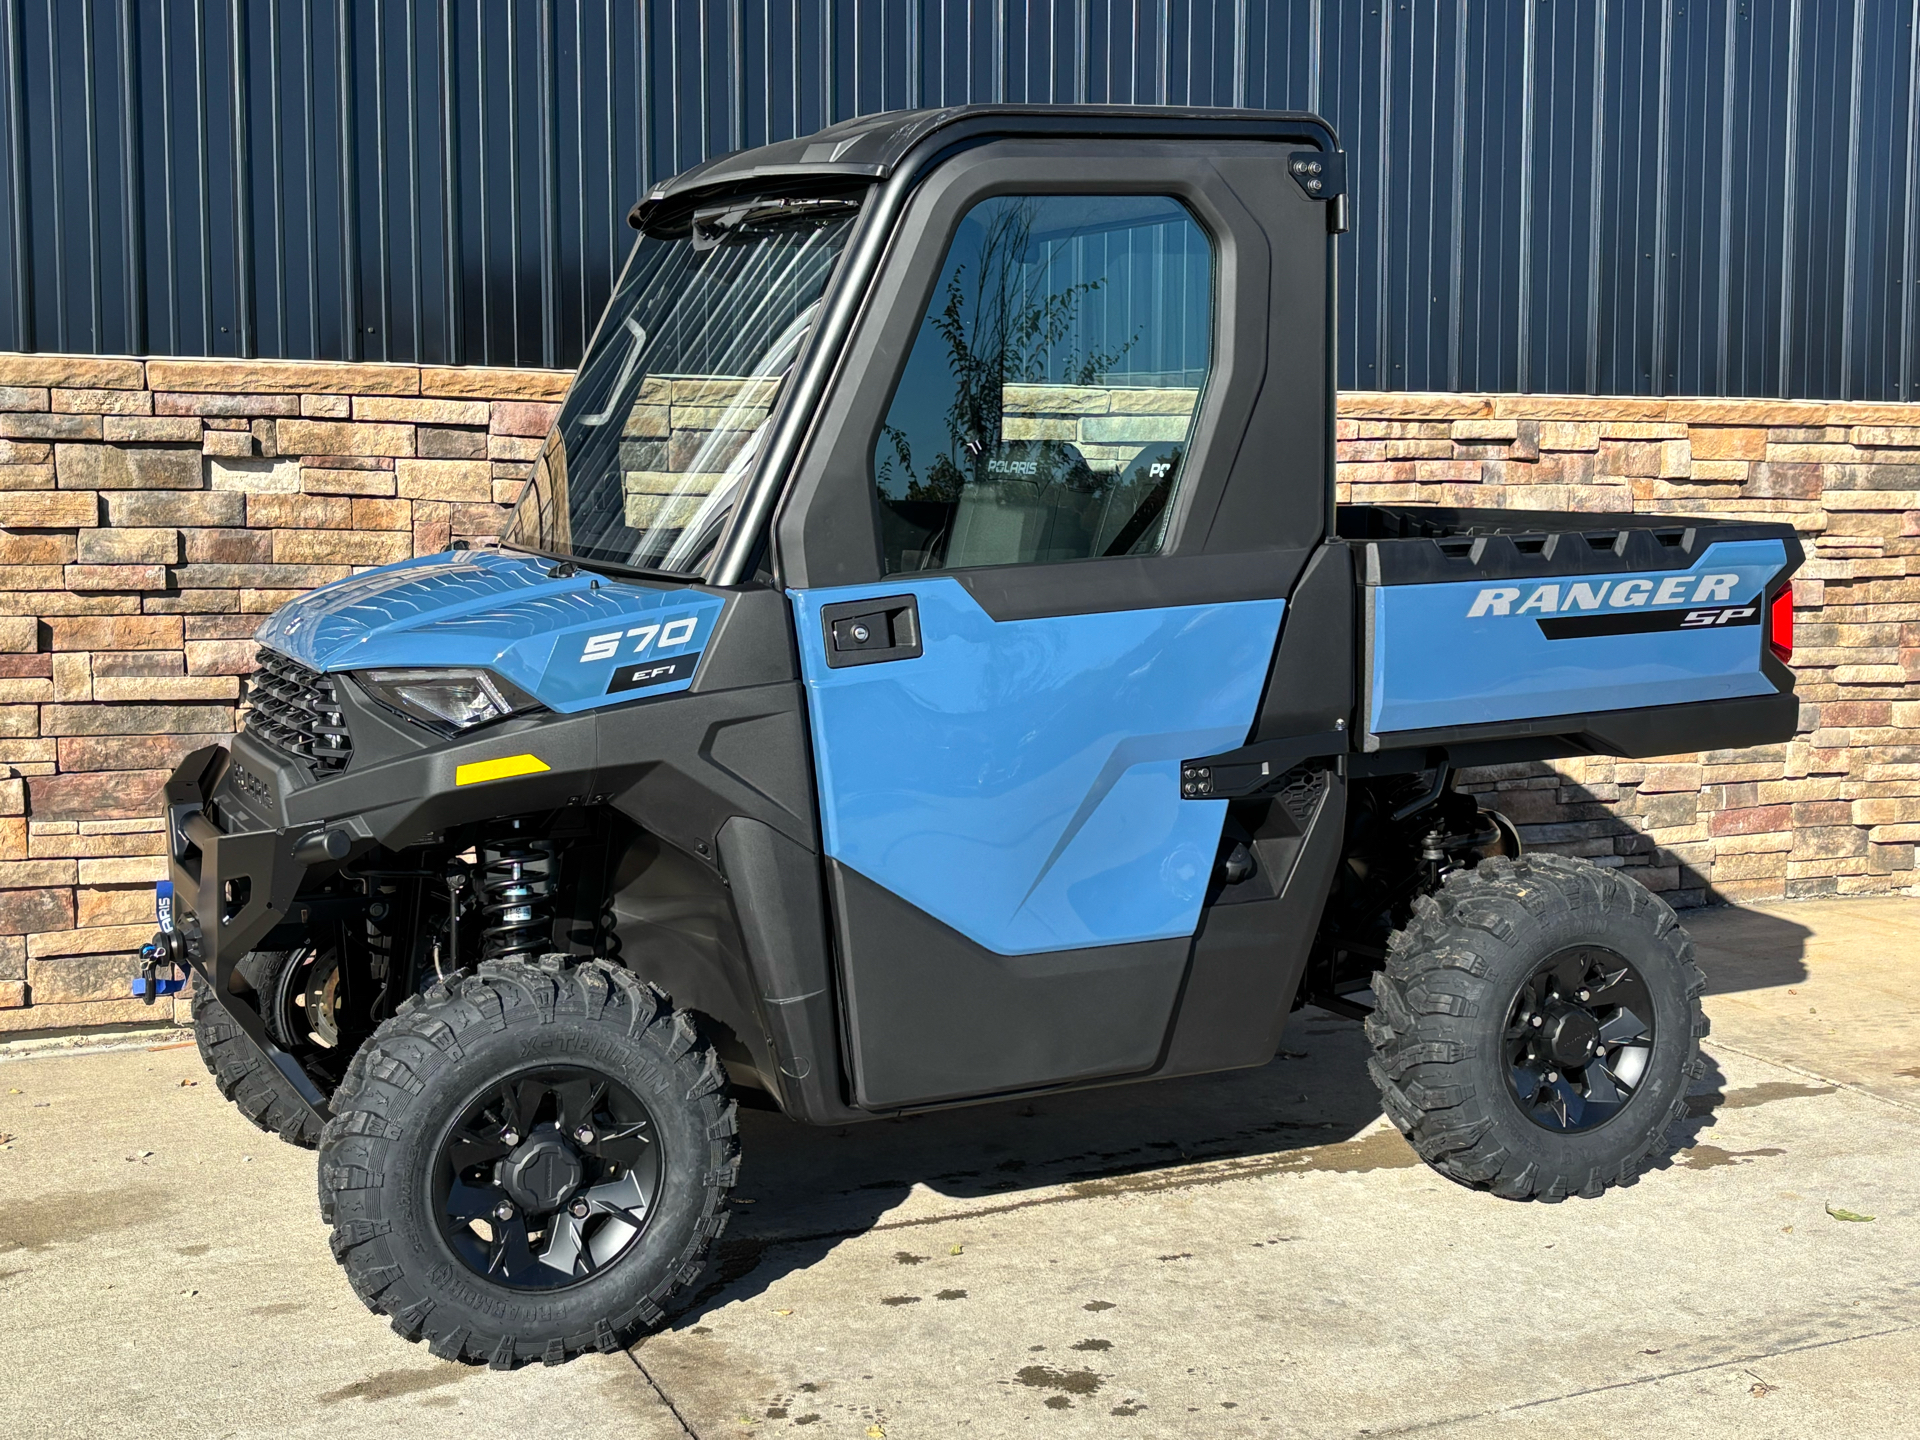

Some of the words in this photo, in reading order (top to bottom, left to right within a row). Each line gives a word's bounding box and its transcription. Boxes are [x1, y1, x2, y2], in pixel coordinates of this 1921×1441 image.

[987, 458, 1038, 475] POLARIS
[1466, 573, 1739, 618] RANGER
[1680, 607, 1757, 627] SP
[579, 616, 698, 663] 570
[631, 664, 676, 682] EFI
[157, 896, 175, 934] ARIS
[518, 1031, 671, 1096] X-TERRAIN
